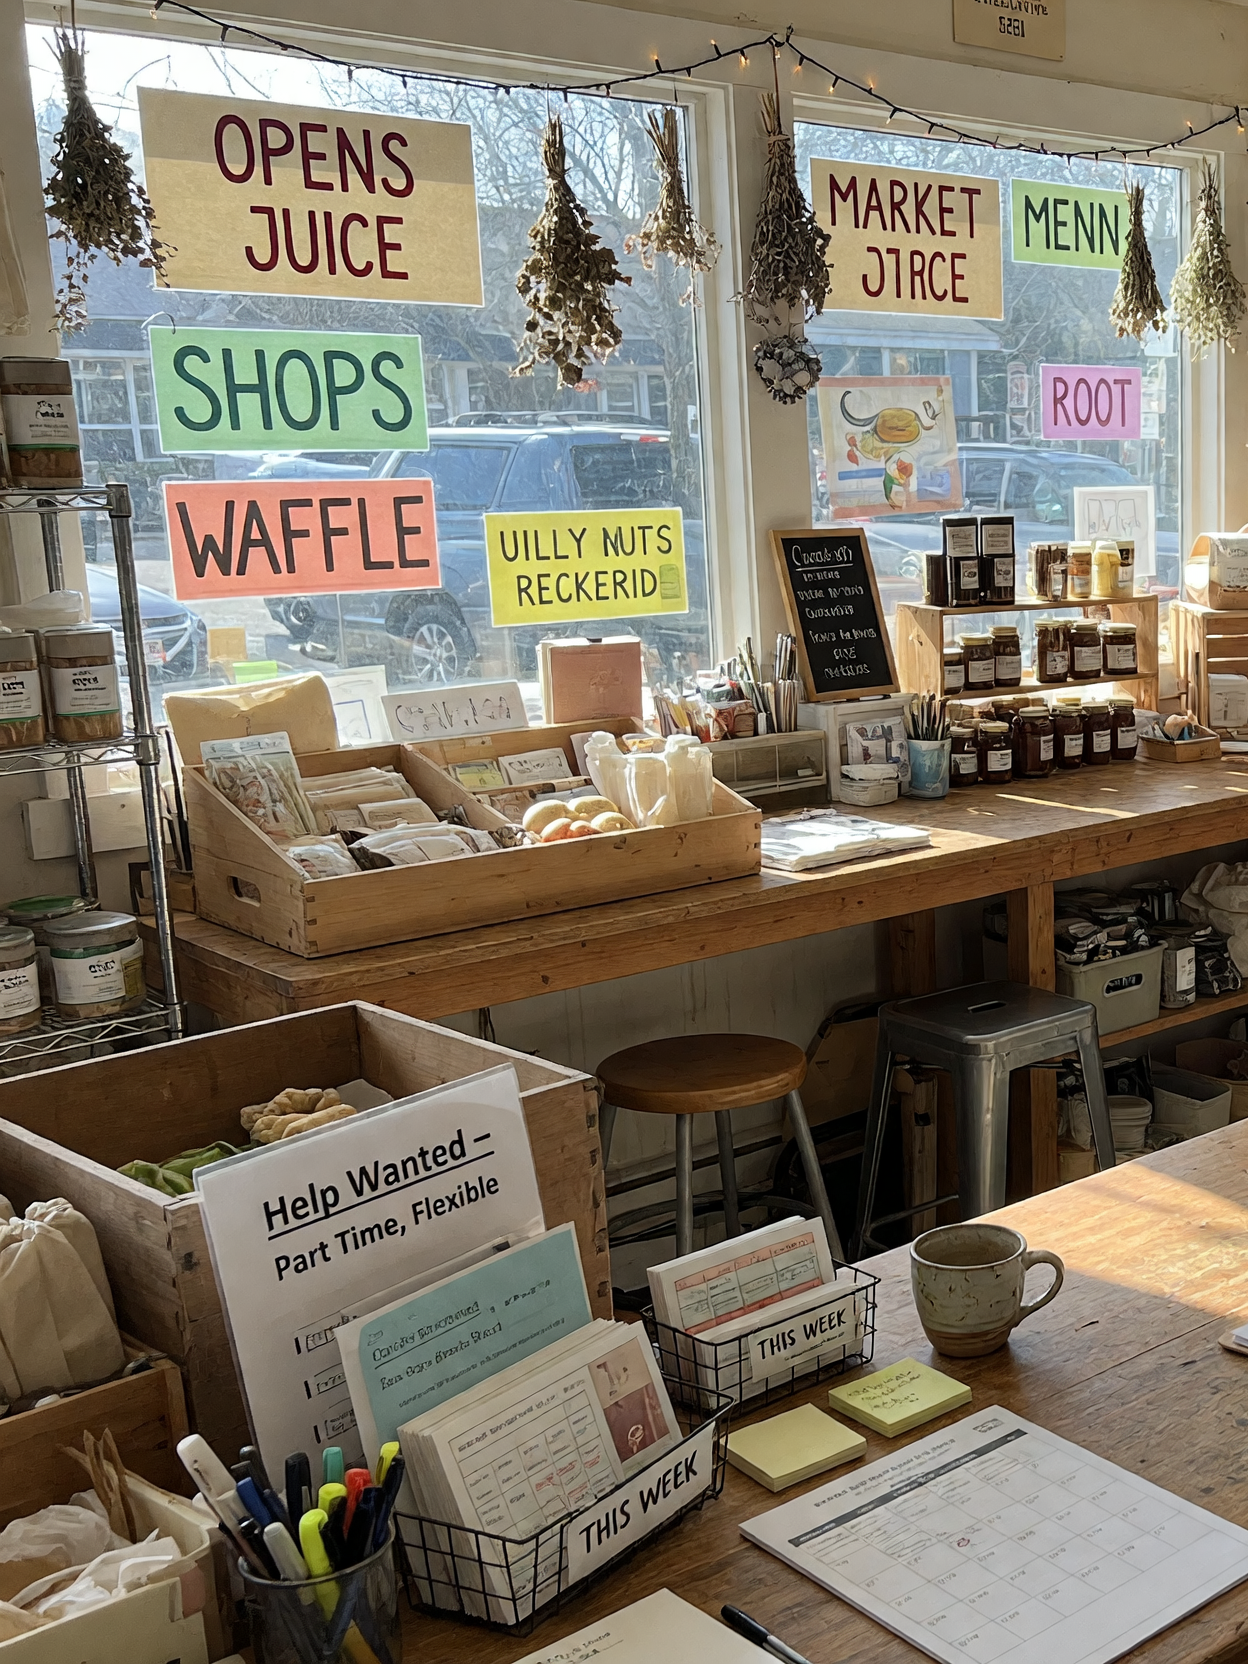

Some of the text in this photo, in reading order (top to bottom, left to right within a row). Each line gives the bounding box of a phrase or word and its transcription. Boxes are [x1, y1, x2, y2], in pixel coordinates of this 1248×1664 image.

[214, 114, 415, 198] OPENS
[245, 205, 408, 281] JUICE
[829, 173, 982, 239] MARKET
[1024, 194, 1119, 256] MENN
[172, 344, 413, 433] SHOPS
[1053, 376, 1132, 427] ROOT
[176, 495, 430, 578] WAFFLE
[500, 524, 672, 562] UILLY NUTS
[517, 568, 657, 607] RECKERID
[263, 1182, 340, 1232] Help
[346, 1128, 468, 1198] Wanted
[274, 1175, 500, 1282] Part Time, Flexible
[756, 1307, 847, 1360] THIS WEEK
[578, 1449, 698, 1554] THIS WEEK
